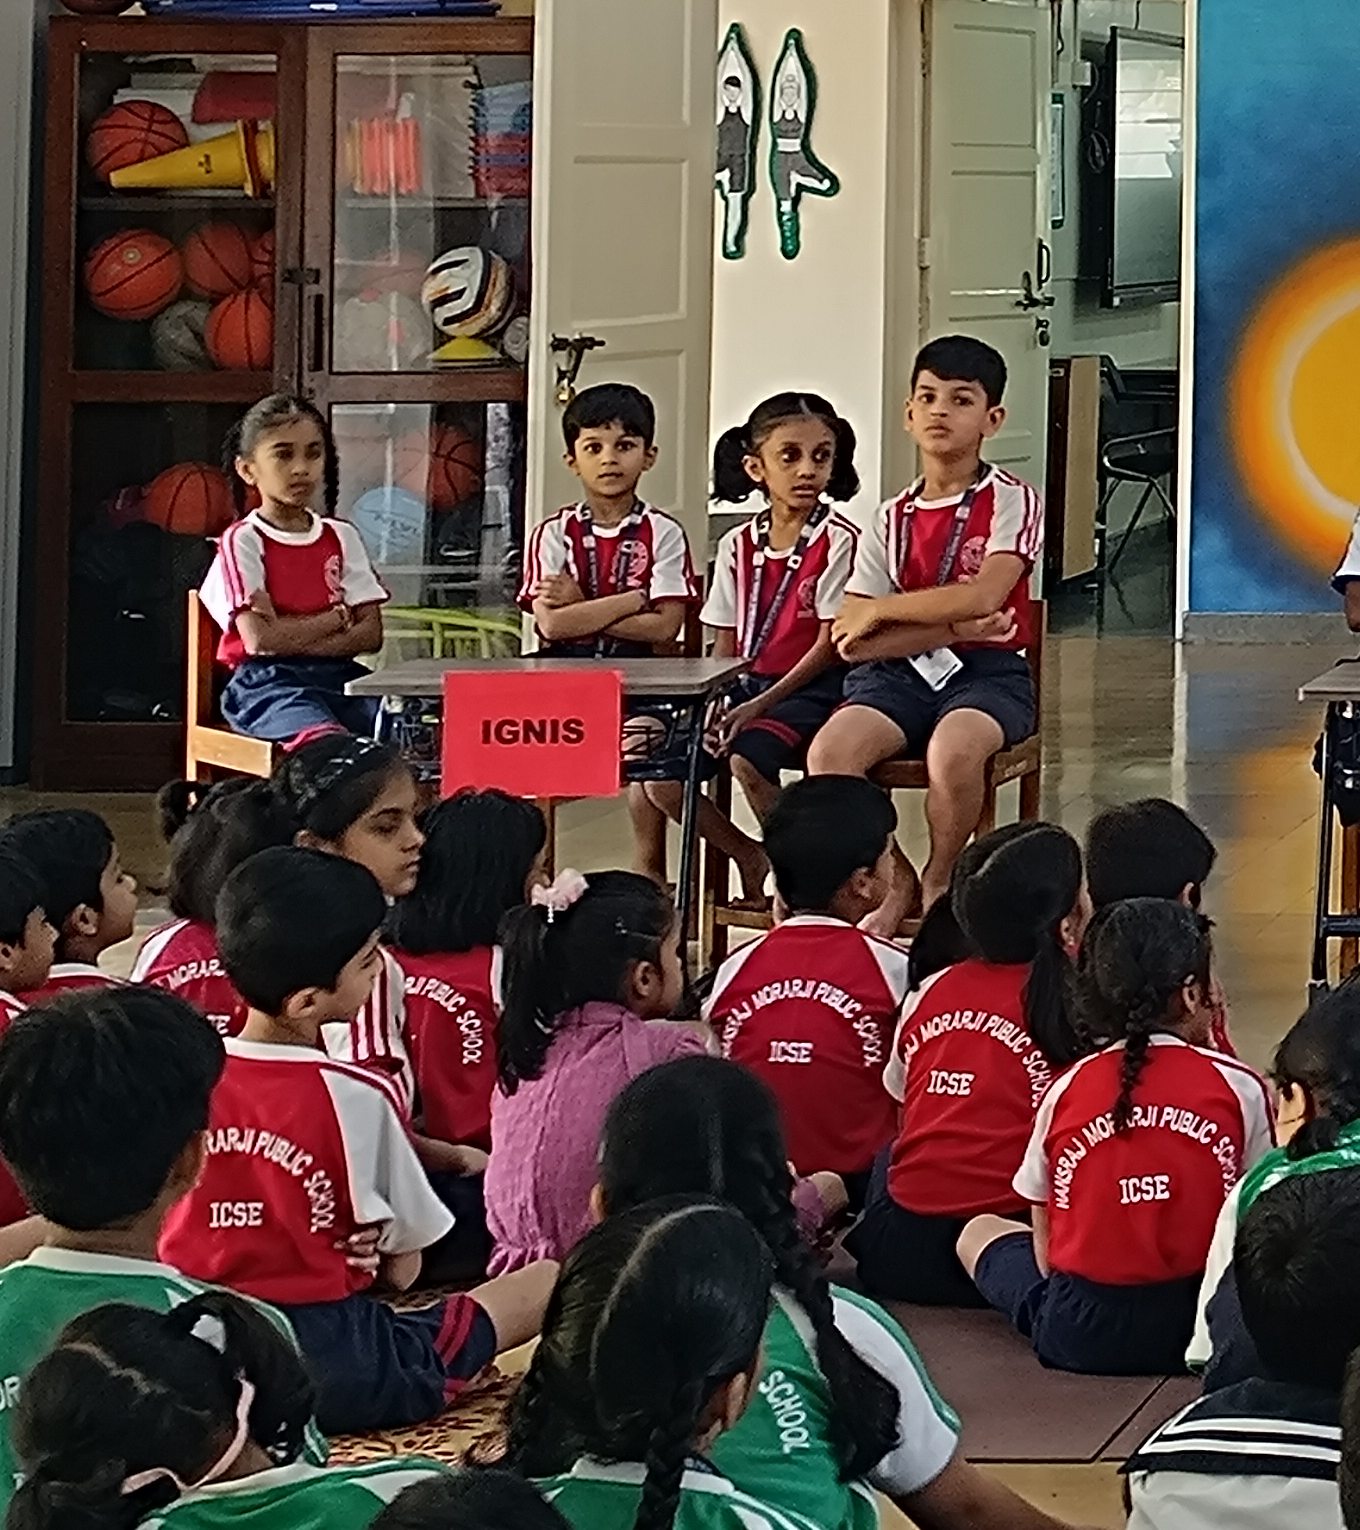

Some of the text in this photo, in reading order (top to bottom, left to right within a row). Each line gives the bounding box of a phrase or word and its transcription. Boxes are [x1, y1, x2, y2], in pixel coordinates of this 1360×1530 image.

[481, 718, 584, 745] IGNIS
[751, 978, 817, 1010] MORARJI
[813, 982, 863, 1019] PUBLIC
[420, 977, 484, 1065] PUBLIC SCHOOL
[920, 1010, 988, 1043] MORARJI
[982, 1015, 1032, 1053] PUBLIC
[768, 1041, 813, 1063] ICSE
[927, 1070, 975, 1095] ICSE
[252, 1130, 314, 1176] PUBLIC
[1054, 1136, 1088, 1209] HANSRAJ
[1159, 1106, 1218, 1144] PUBLIC
[1119, 1174, 1171, 1205] ICSE
[209, 1202, 264, 1228] ICSE
[758, 1370, 810, 1454] SCHOOL
